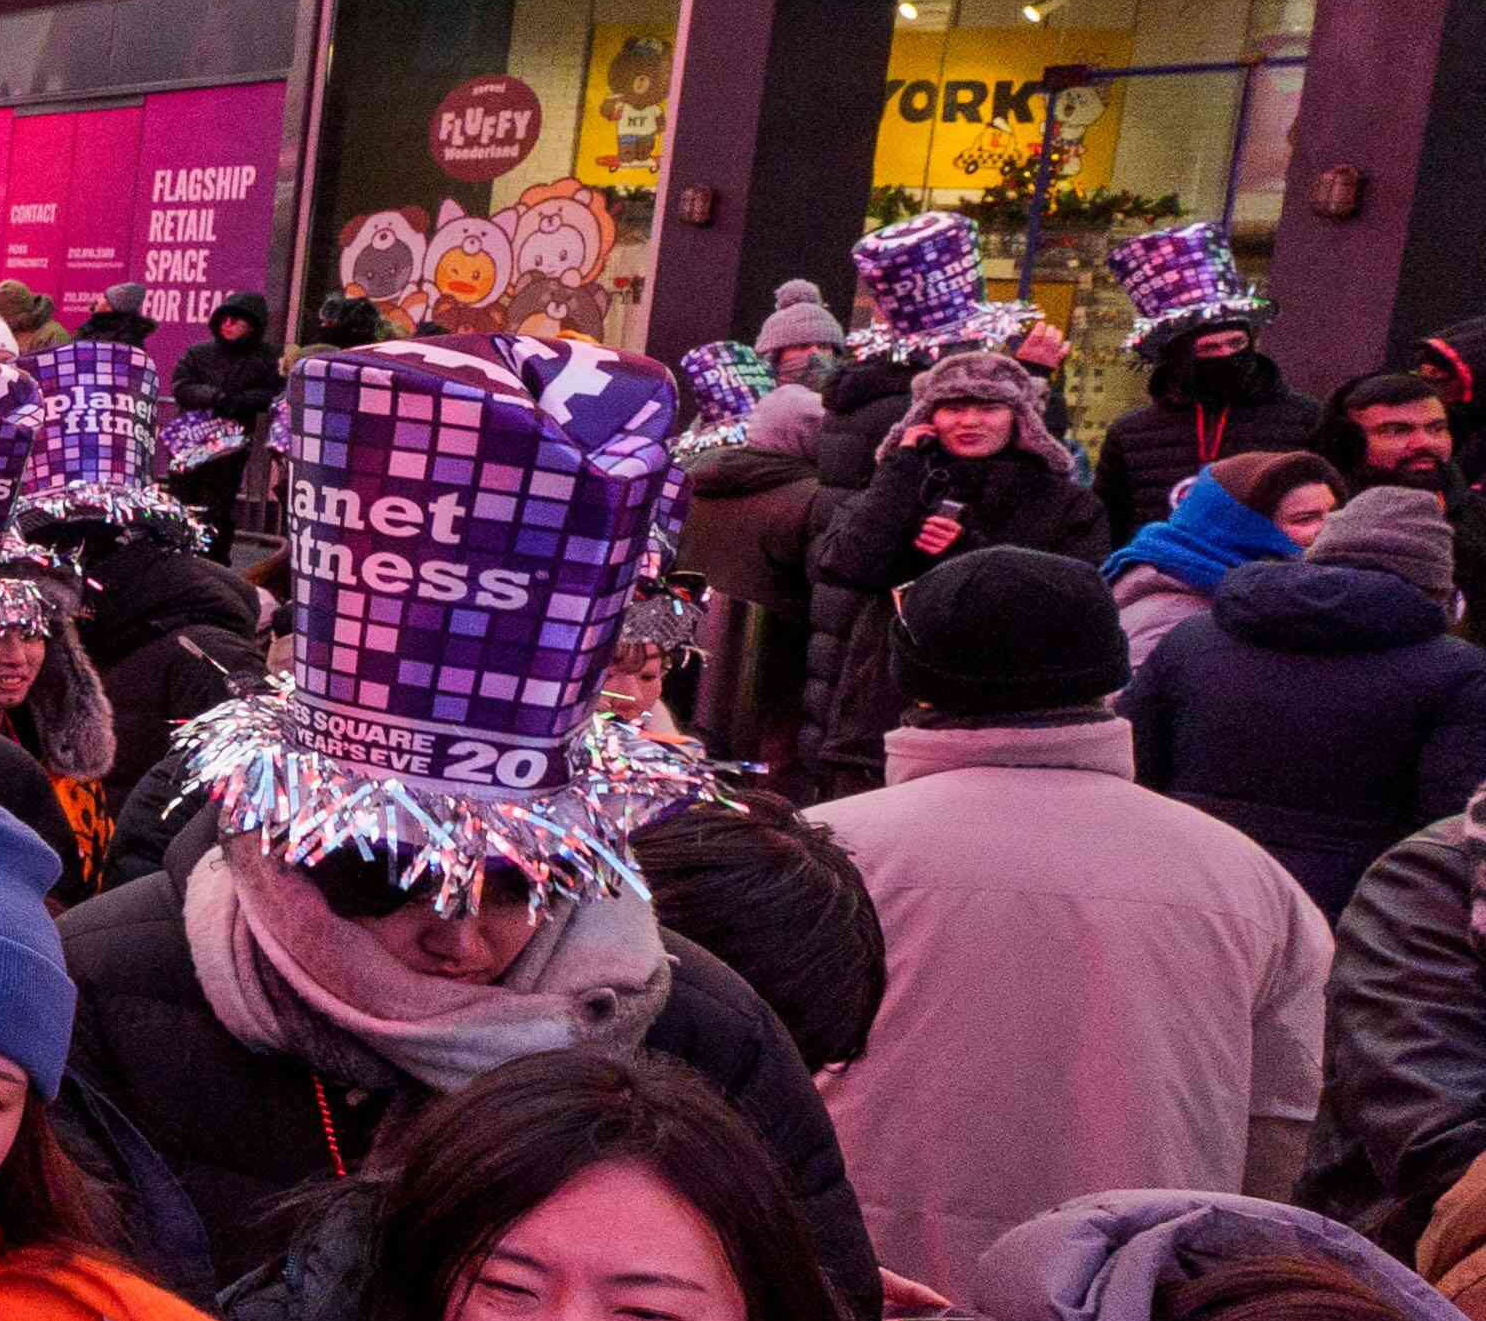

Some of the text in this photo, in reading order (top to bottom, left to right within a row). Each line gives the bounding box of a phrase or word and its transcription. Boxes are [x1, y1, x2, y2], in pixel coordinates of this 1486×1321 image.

[439, 107, 532, 147] FLUFFY
[444, 143, 520, 161] Wonderland
[152, 166, 256, 202] FLAGSHIP
[10, 203, 57, 224] CONTACT
[149, 209, 216, 242] RETAIL
[145, 249, 210, 283] SPACE
[142, 290, 180, 323] FOR
[44, 385, 155, 422] planet
[313, 710, 436, 754] SQUARE
[370, 747, 432, 775] EVE
[443, 741, 549, 788] 20
